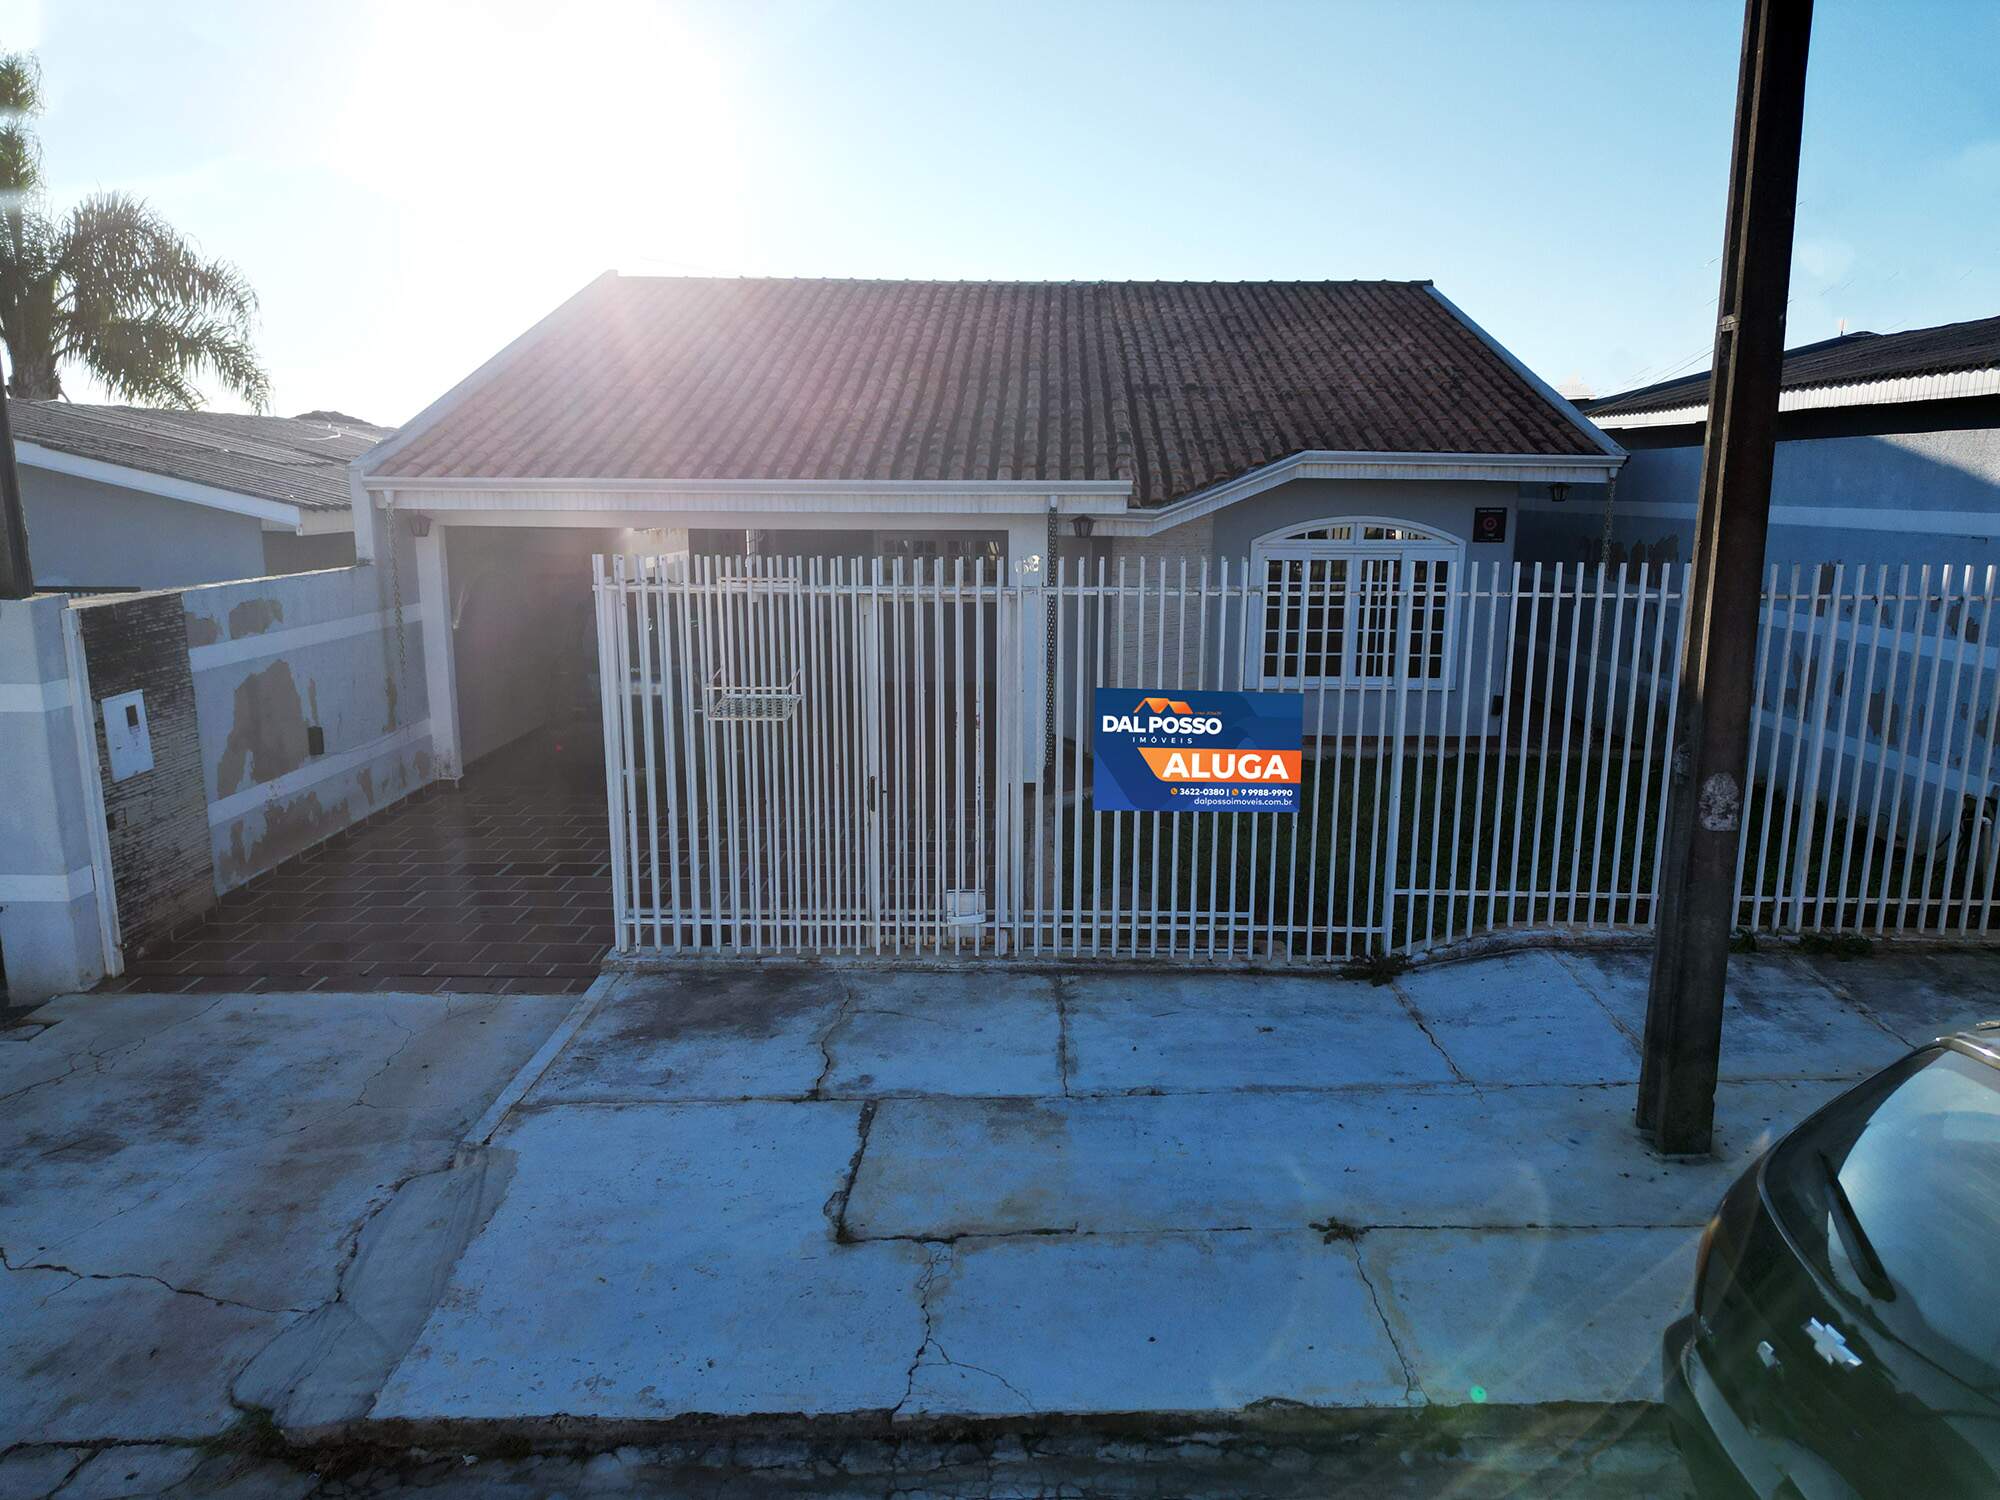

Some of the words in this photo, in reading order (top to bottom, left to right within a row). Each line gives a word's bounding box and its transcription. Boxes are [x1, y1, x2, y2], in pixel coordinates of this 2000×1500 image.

[1102, 715, 1146, 733] DAL
[1148, 716, 1222, 735] POSSO
[1132, 736, 1193, 744] IMÓVEIS
[1162, 752, 1289, 780] ALUGA
[1180, 788, 1225, 796] 3622-0380
[1248, 789, 1293, 797] 9988-9990
[1194, 797, 1293, 806] dalpossoimoveis.com.br
